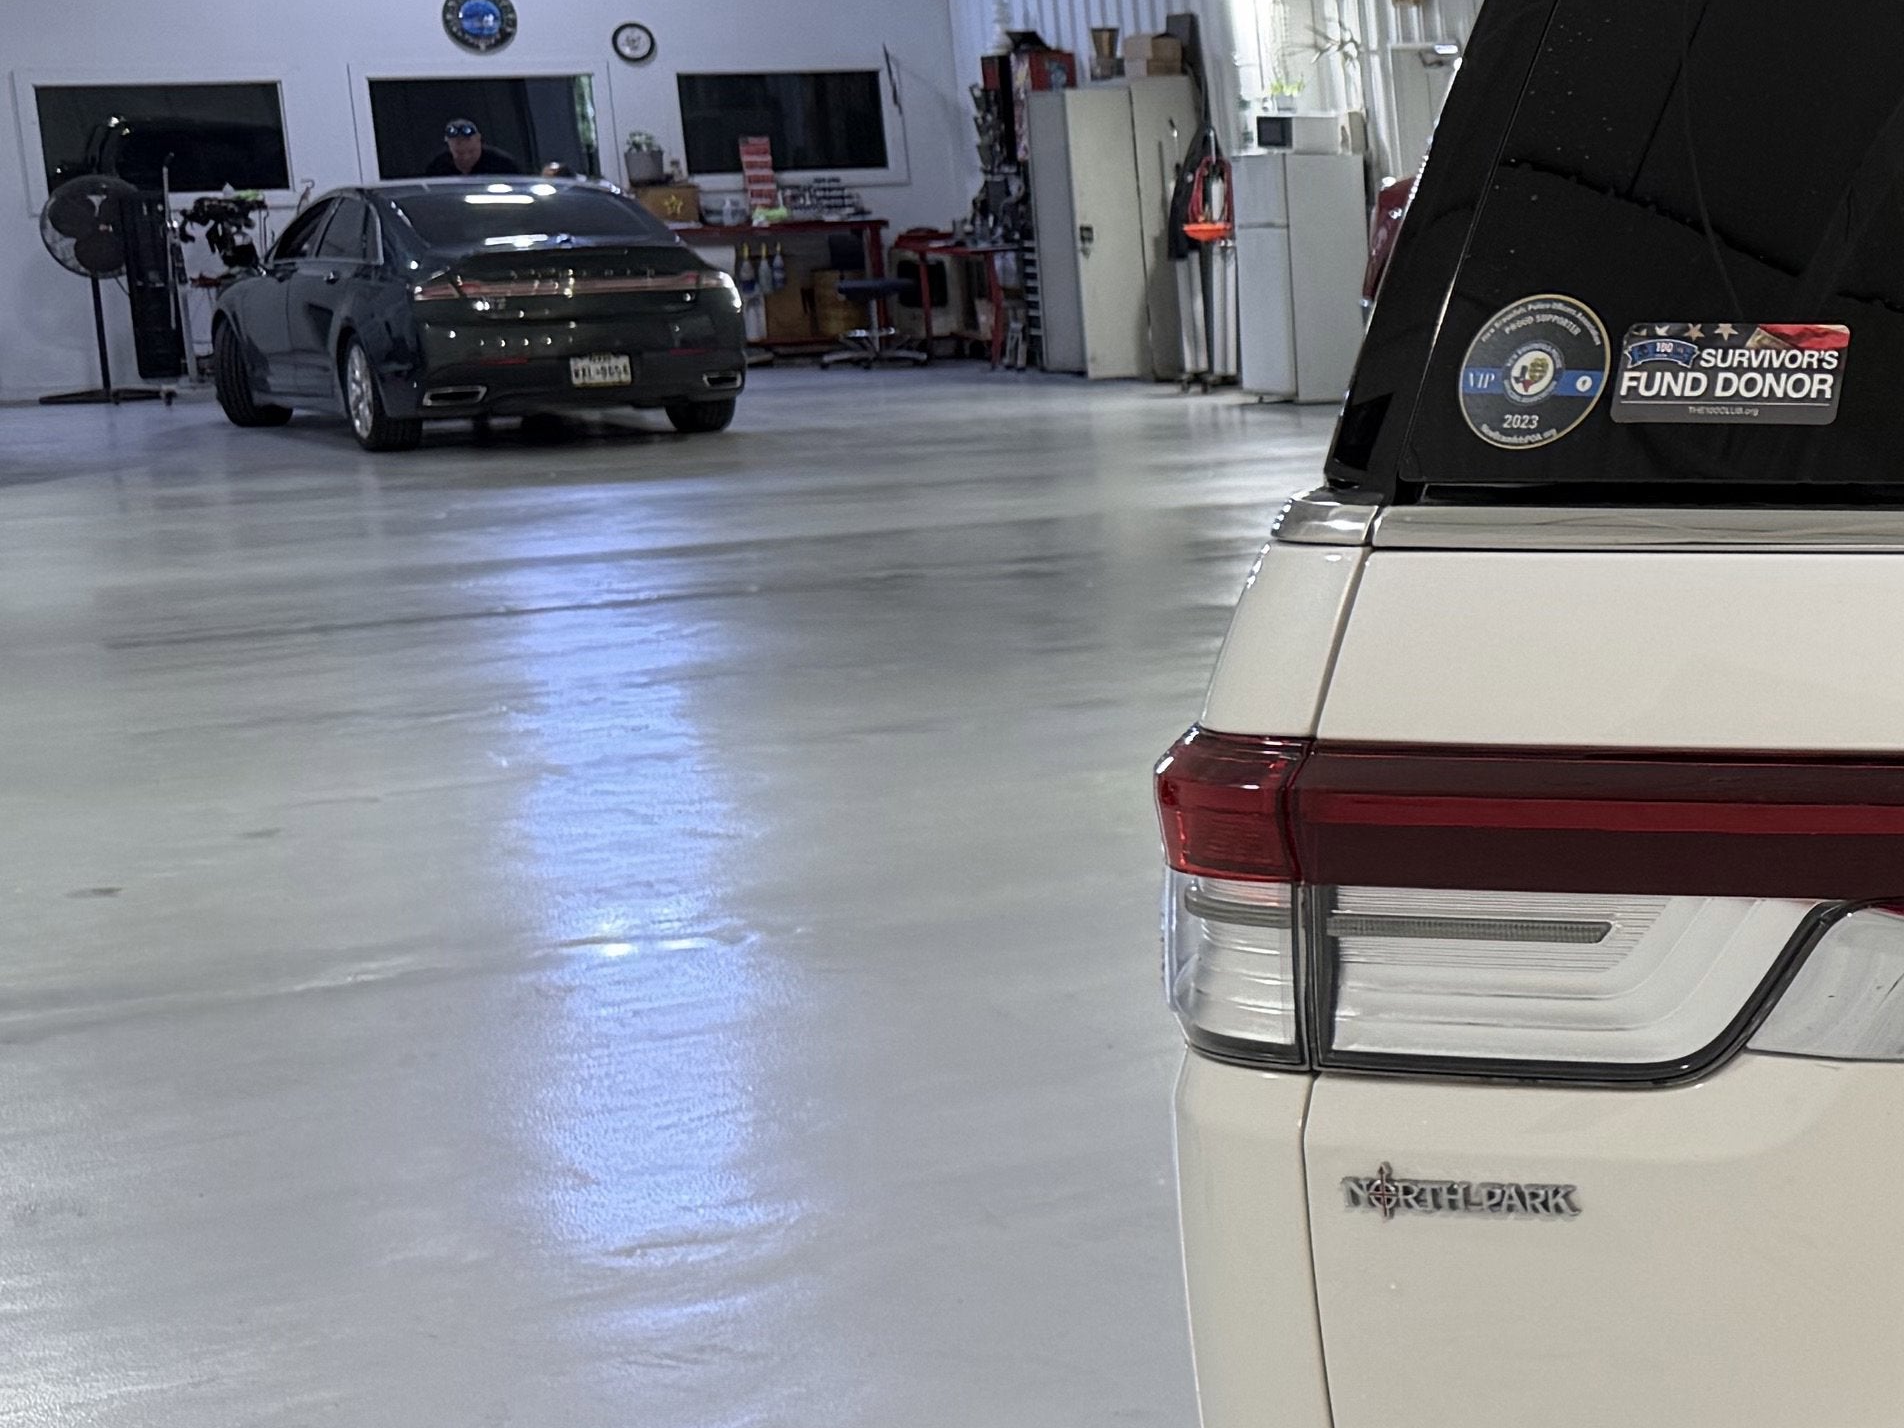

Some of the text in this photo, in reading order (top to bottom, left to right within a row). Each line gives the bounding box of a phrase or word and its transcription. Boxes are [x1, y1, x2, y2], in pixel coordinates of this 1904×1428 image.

[1700, 349, 1839, 369] SURVIVOR'S
[1468, 373, 1495, 389] VIP
[1619, 372, 1834, 399] FUND DONOR
[1502, 415, 1540, 429] 2023
[1342, 1176, 1582, 1217] NORTH PARK
